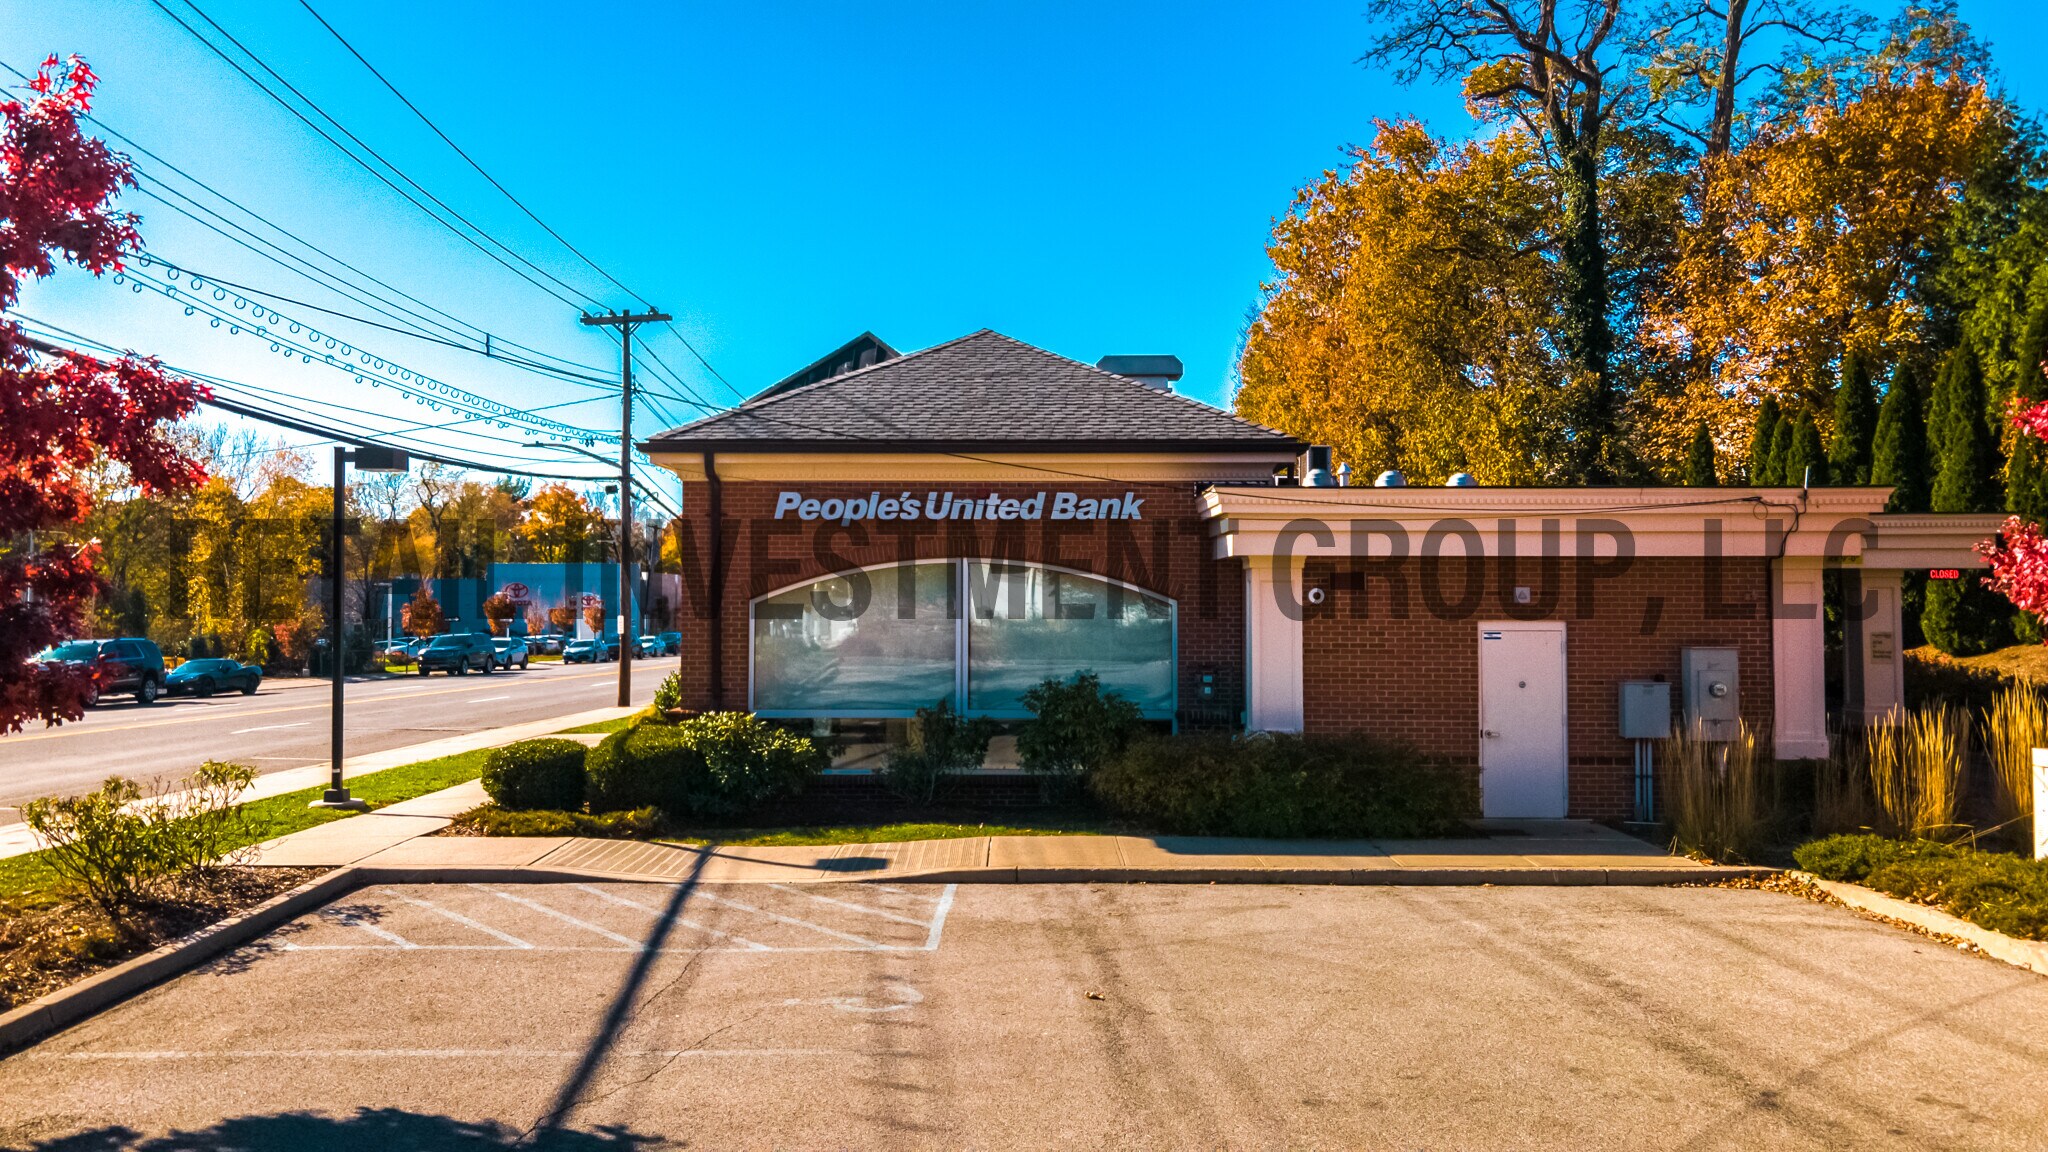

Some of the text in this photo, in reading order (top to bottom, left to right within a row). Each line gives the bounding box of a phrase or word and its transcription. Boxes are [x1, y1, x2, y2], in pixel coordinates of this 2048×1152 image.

[774, 491, 1145, 527] People's United Bank
[1930, 569, 1960, 579] CLOSED
